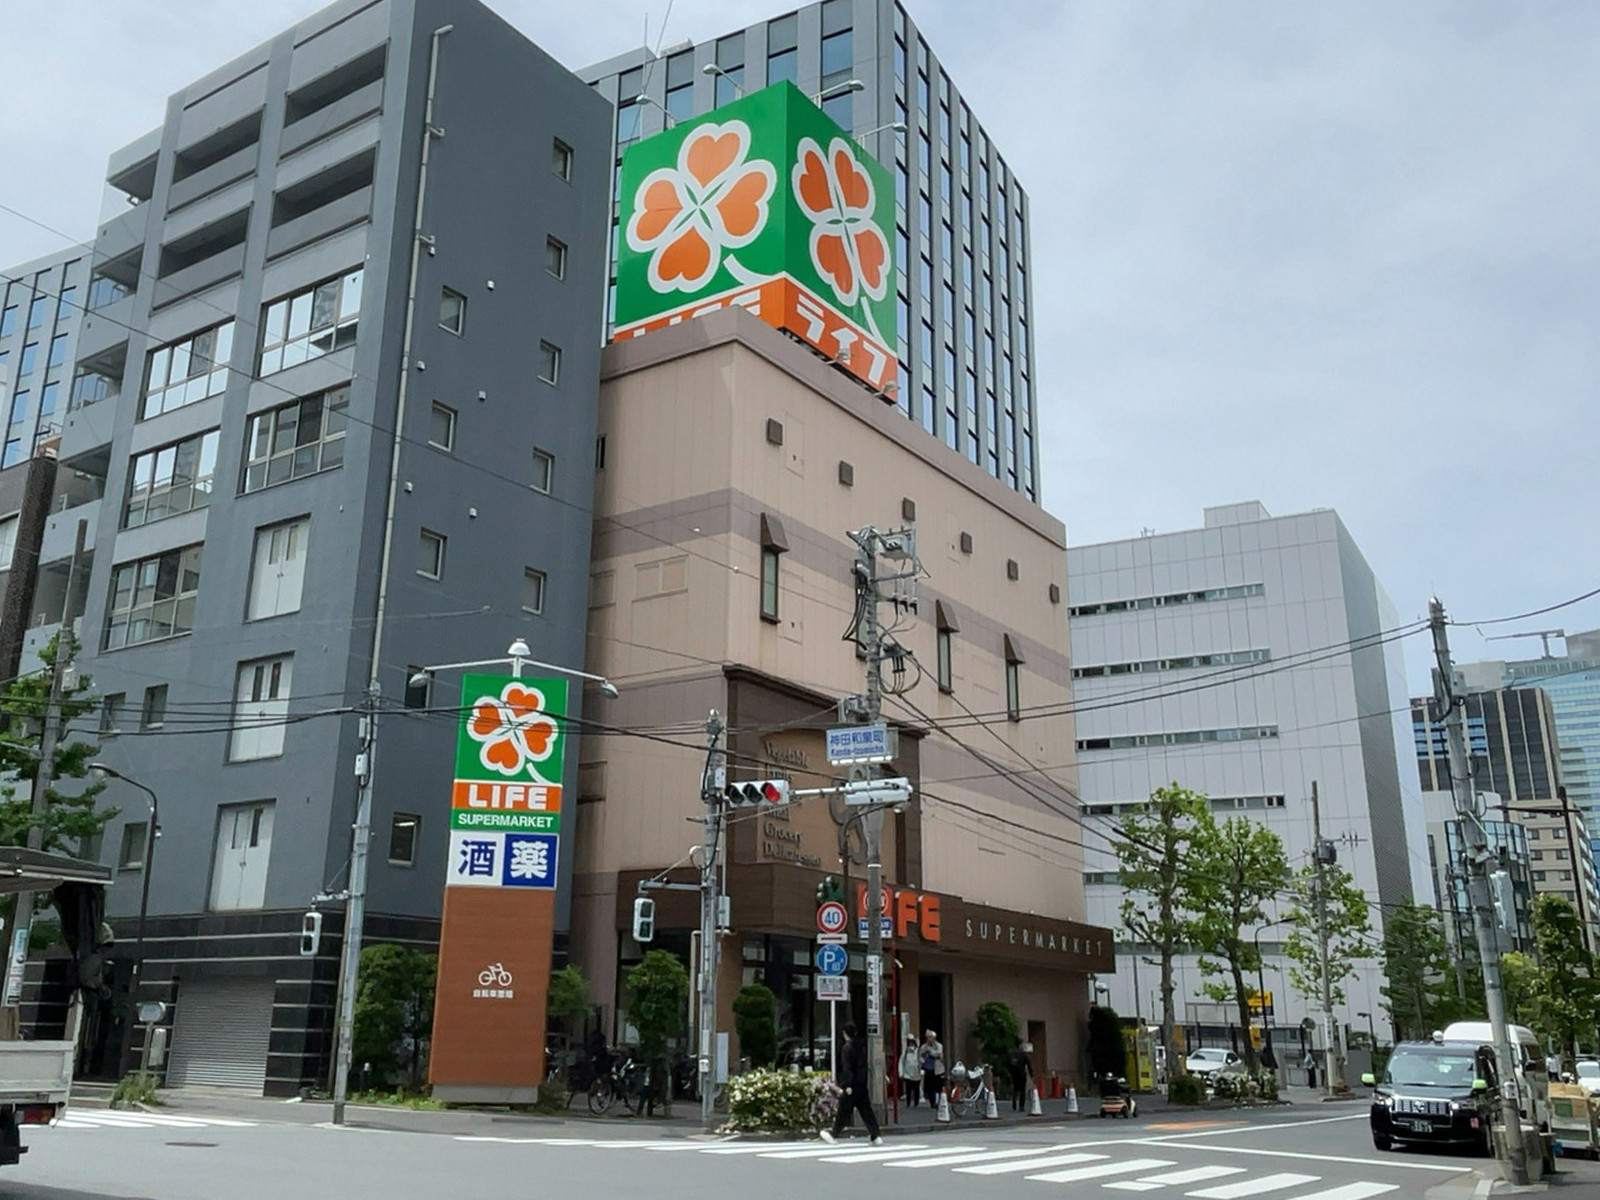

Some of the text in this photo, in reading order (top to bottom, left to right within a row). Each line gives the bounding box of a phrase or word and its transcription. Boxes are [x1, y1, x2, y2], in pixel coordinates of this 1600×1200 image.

[796, 294, 887, 385] ライフ
[468, 784, 548, 810] LIFE
[458, 813, 553, 829] SUPERMARKET
[457, 839, 549, 879] 酒 薬
[824, 911, 841, 925] 40
[965, 919, 1102, 956] SUPERMARKET
[823, 951, 836, 972] P
